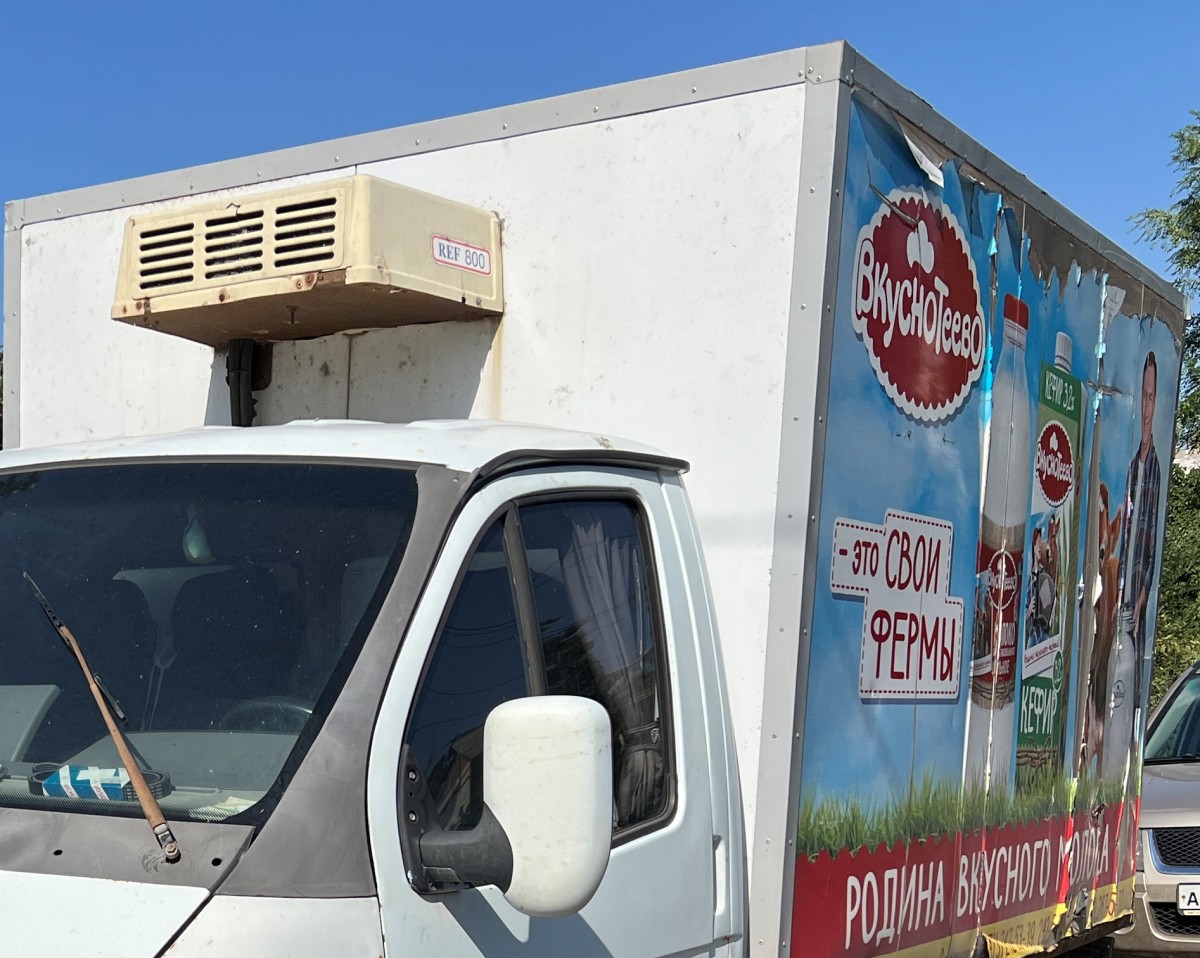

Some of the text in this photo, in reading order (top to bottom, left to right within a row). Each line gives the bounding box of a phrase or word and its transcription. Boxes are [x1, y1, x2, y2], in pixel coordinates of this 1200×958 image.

[438, 242, 485, 269] REF 800
[886, 529, 942, 594] СВОИ
[870, 609, 956, 682] ФЕРМЫ
[1020, 685, 1058, 734] КЕФИР
[845, 859, 943, 950] РОДИНА
[956, 838, 1050, 918] ВКУСНОГО
